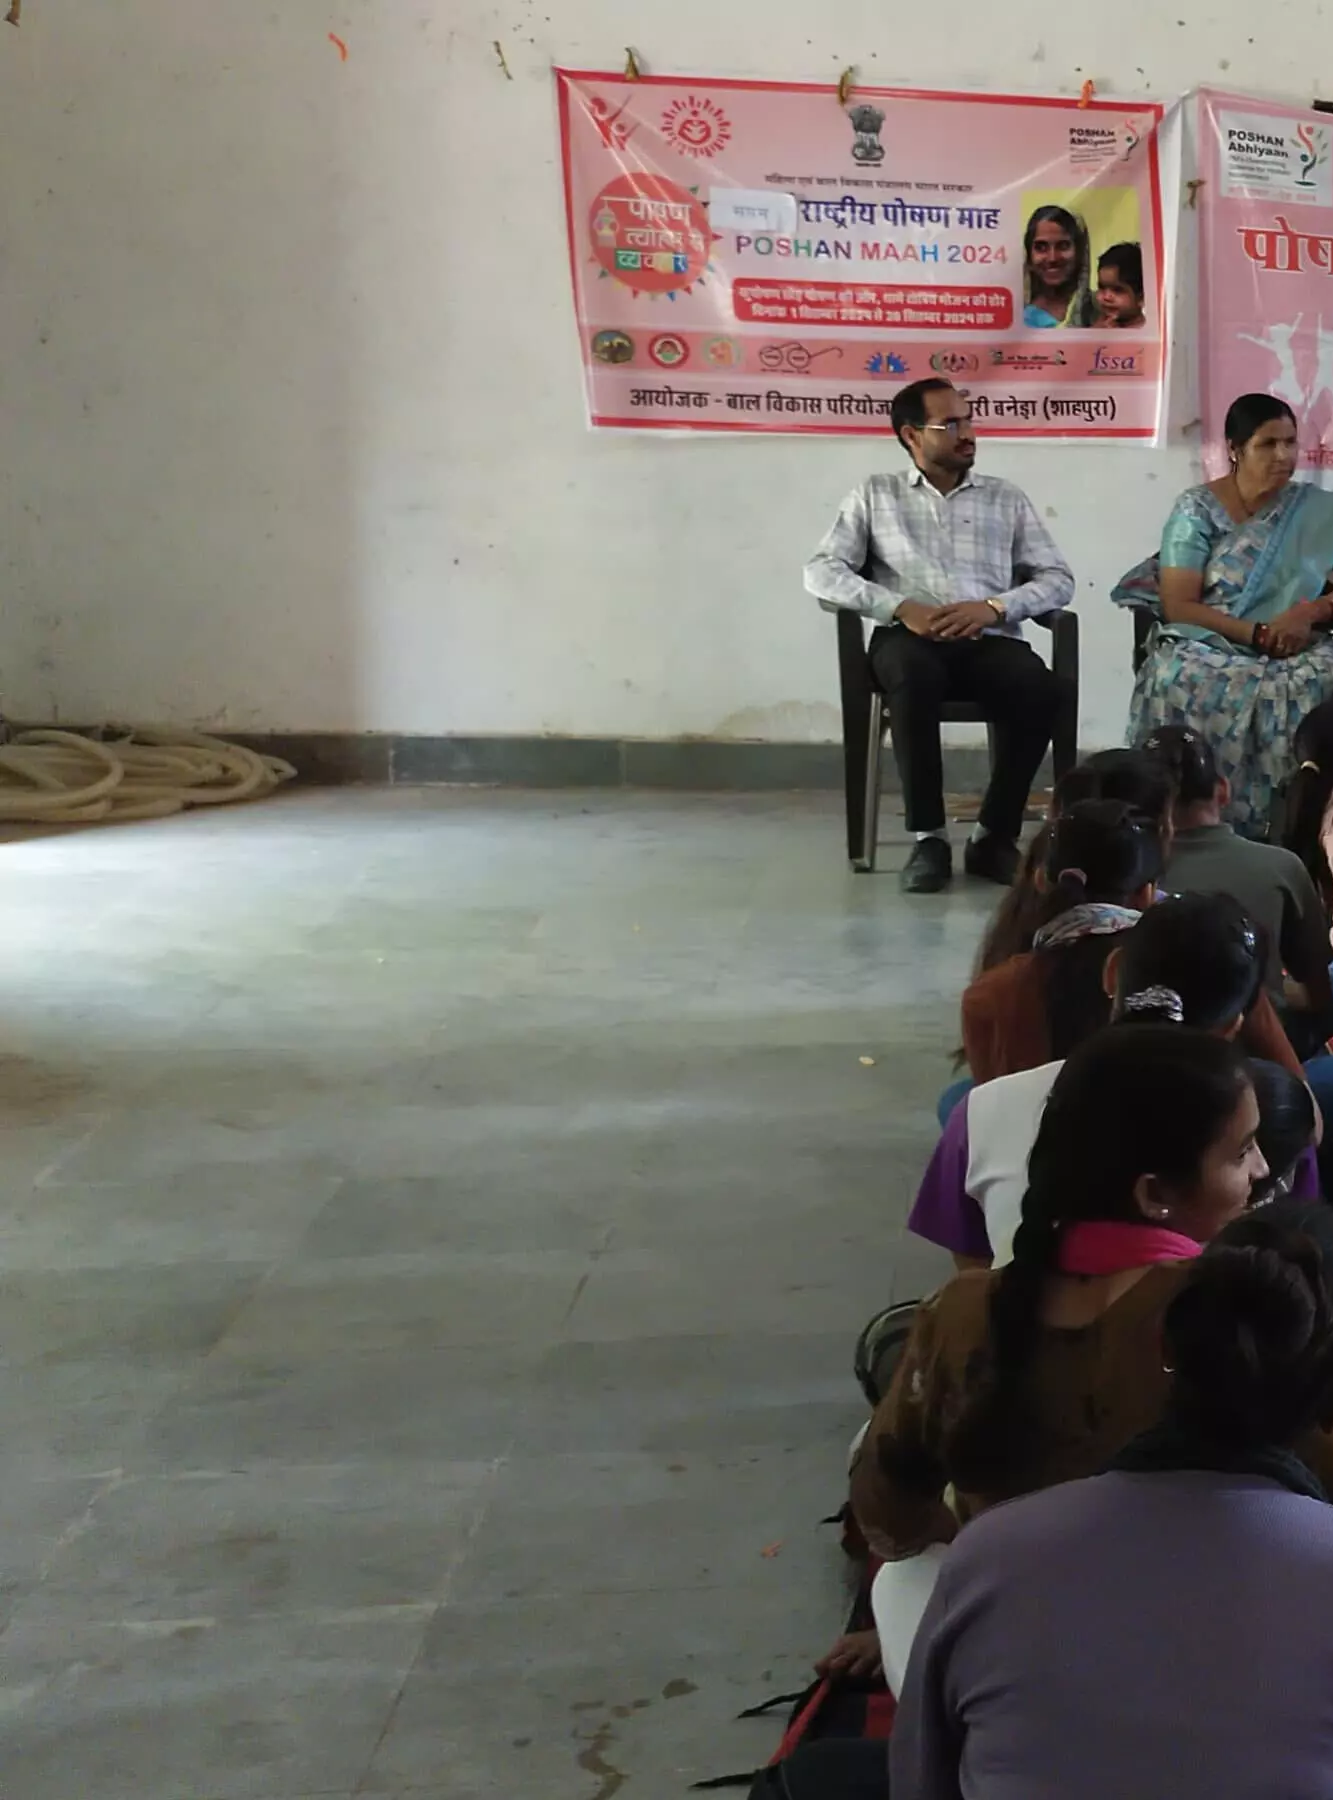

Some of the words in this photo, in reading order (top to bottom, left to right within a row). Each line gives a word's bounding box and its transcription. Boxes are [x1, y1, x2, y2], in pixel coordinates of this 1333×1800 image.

[1228, 129, 1285, 147] POSHAN
[1228, 141, 1289, 158] Abhiyaan
[801, 195, 877, 229] राष्ट्रीय
[881, 198, 951, 229] पोषण
[952, 206, 1001, 230] माह
[735, 235, 852, 261] POSHAN
[860, 240, 939, 262] MAAH
[947, 245, 1009, 265] 2024
[630, 385, 710, 409] आयोजक
[726, 392, 761, 412] बाल
[766, 389, 822, 414] विकास
[825, 392, 893, 416] परियोज
[1043, 395, 1117, 421] (शाहपुरा)
